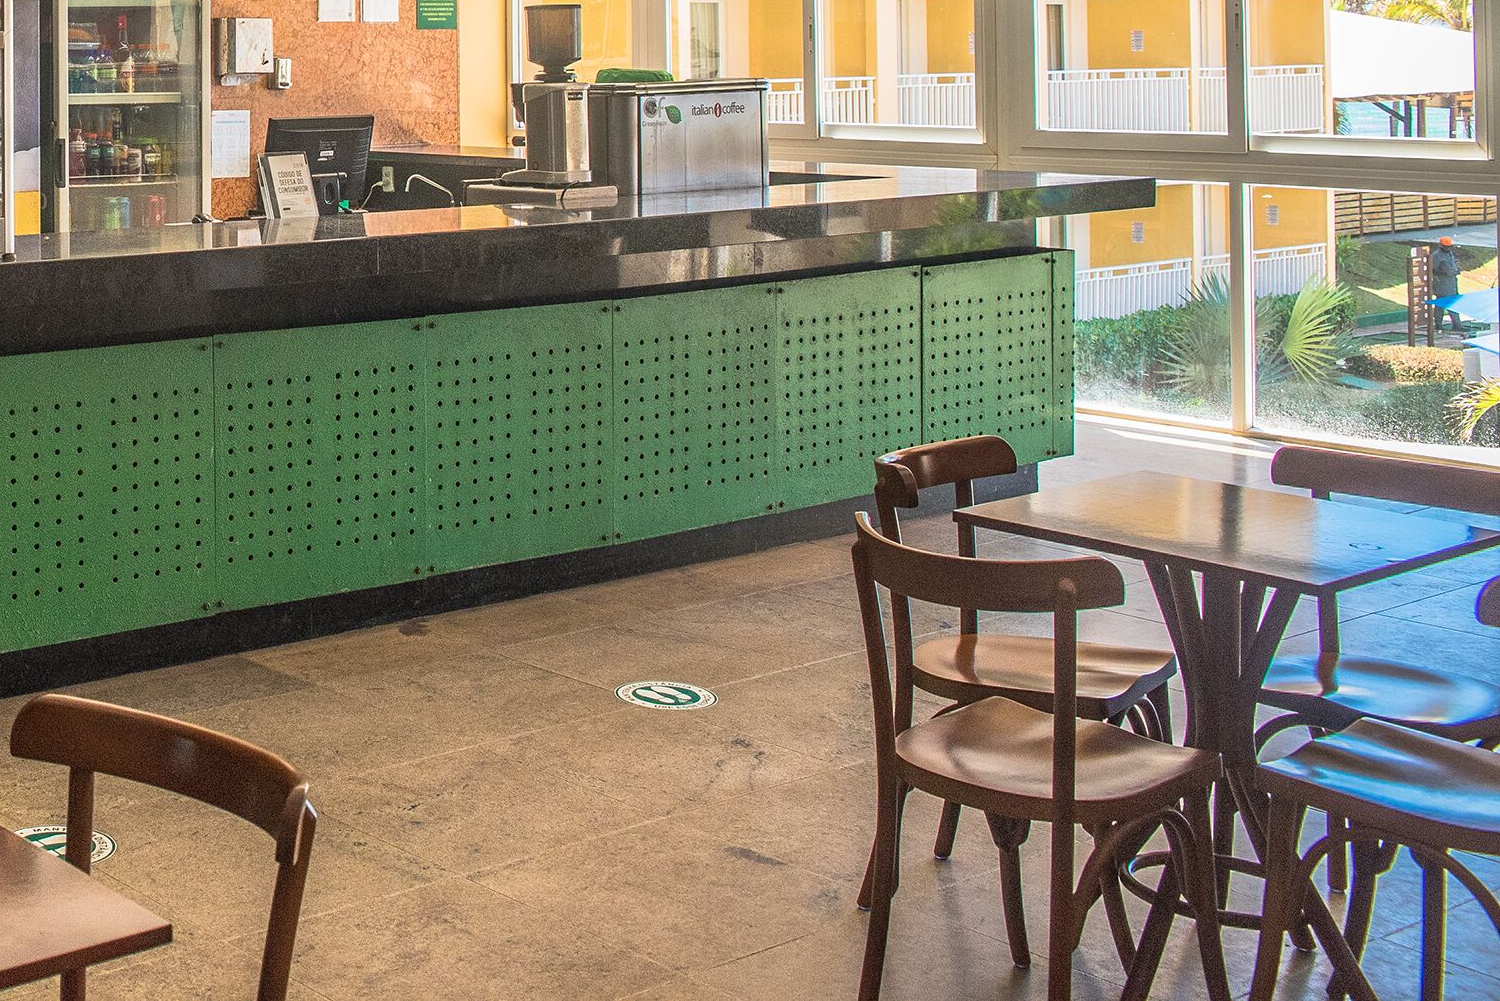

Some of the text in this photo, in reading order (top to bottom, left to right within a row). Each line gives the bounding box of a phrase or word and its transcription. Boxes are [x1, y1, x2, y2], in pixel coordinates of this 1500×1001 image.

[691, 102, 745, 116] italian coffee
[277, 170, 296, 178] CÓDIGO
[279, 177, 304, 186] DEFESA DO
[277, 185, 308, 194] CONSUMIDOR
